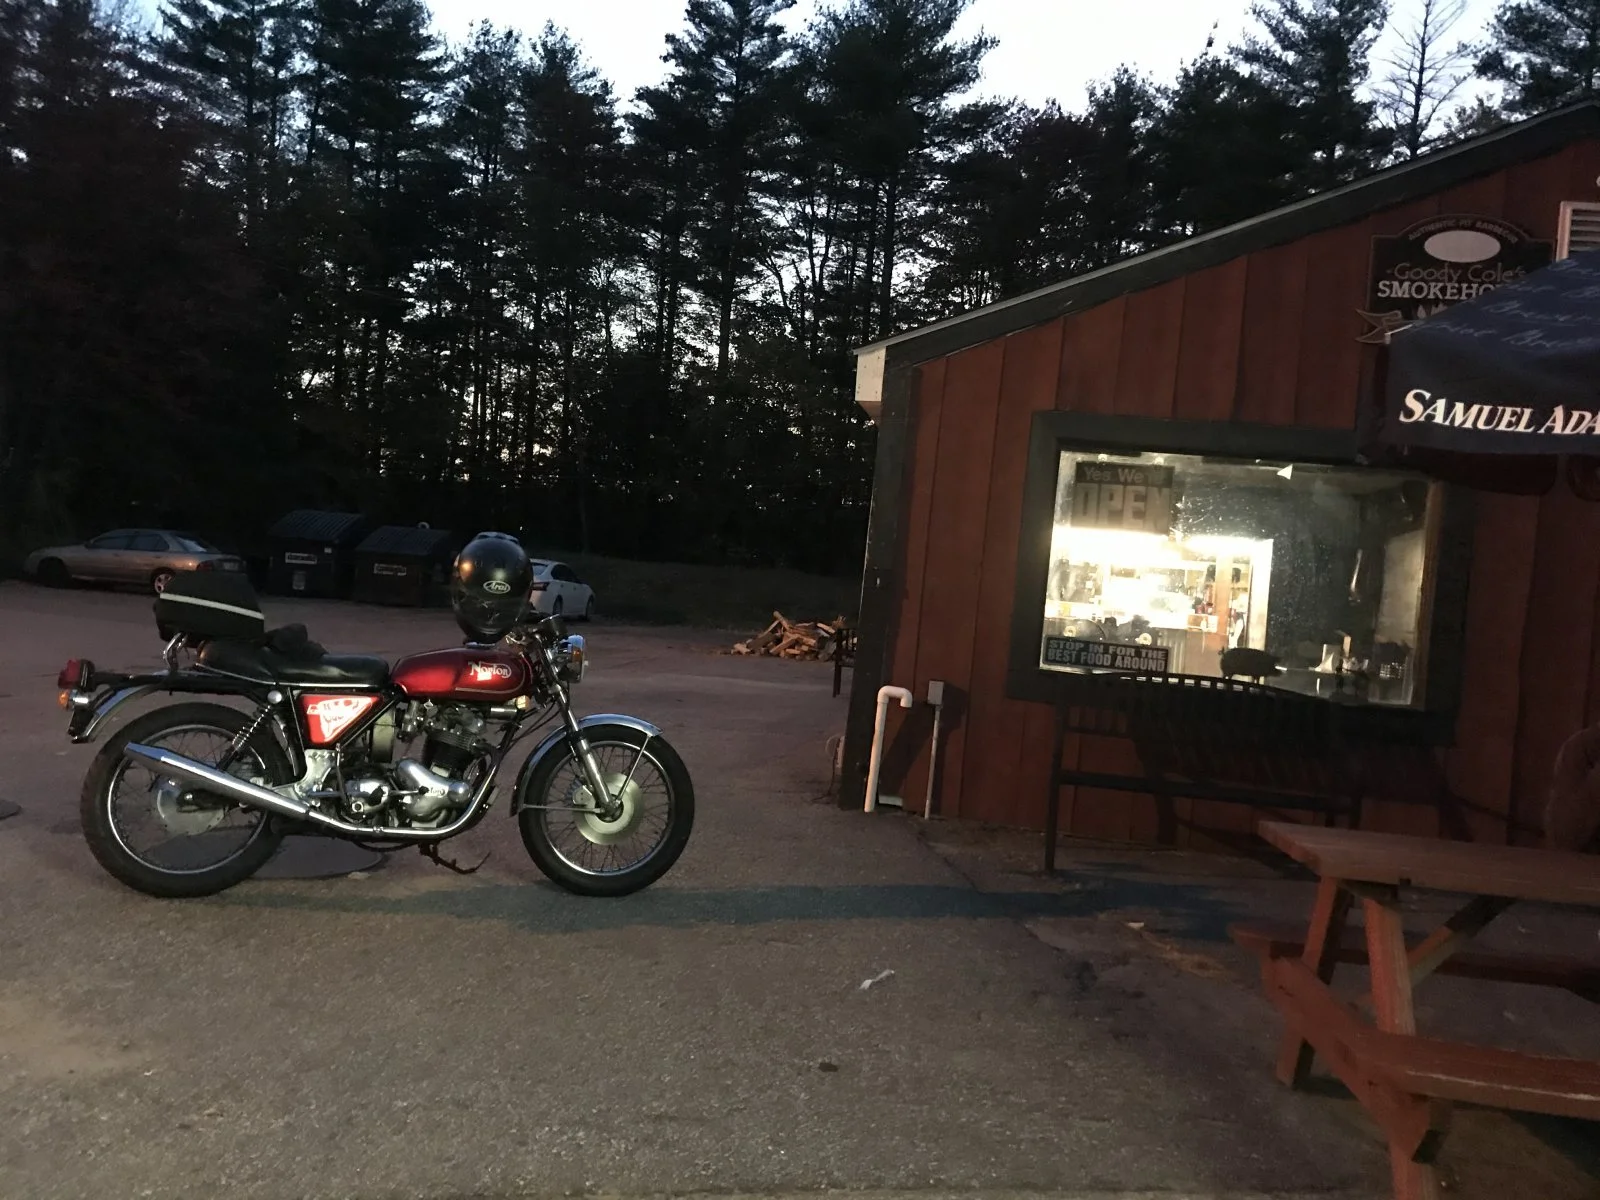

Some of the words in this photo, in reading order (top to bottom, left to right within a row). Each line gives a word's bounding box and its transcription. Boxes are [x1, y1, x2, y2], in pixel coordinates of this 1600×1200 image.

[1394, 262, 1461, 283] Goody
[1468, 263, 1526, 282] Cole's
[1377, 281, 1499, 300] SMOKEHO
[1399, 389, 1535, 433] SAMUEL
[1084, 466, 1112, 481] Yes
[1074, 483, 1170, 532] OPEN
[1049, 640, 1084, 650] STOP
[1090, 644, 1104, 653] IN
[1110, 646, 1136, 656] FOR
[1141, 648, 1166, 659] THE
[468, 661, 512, 678] Norton
[1047, 650, 1076, 662] BEST
[1080, 653, 1111, 666] FOOD
[1115, 656, 1166, 671] AROUND
